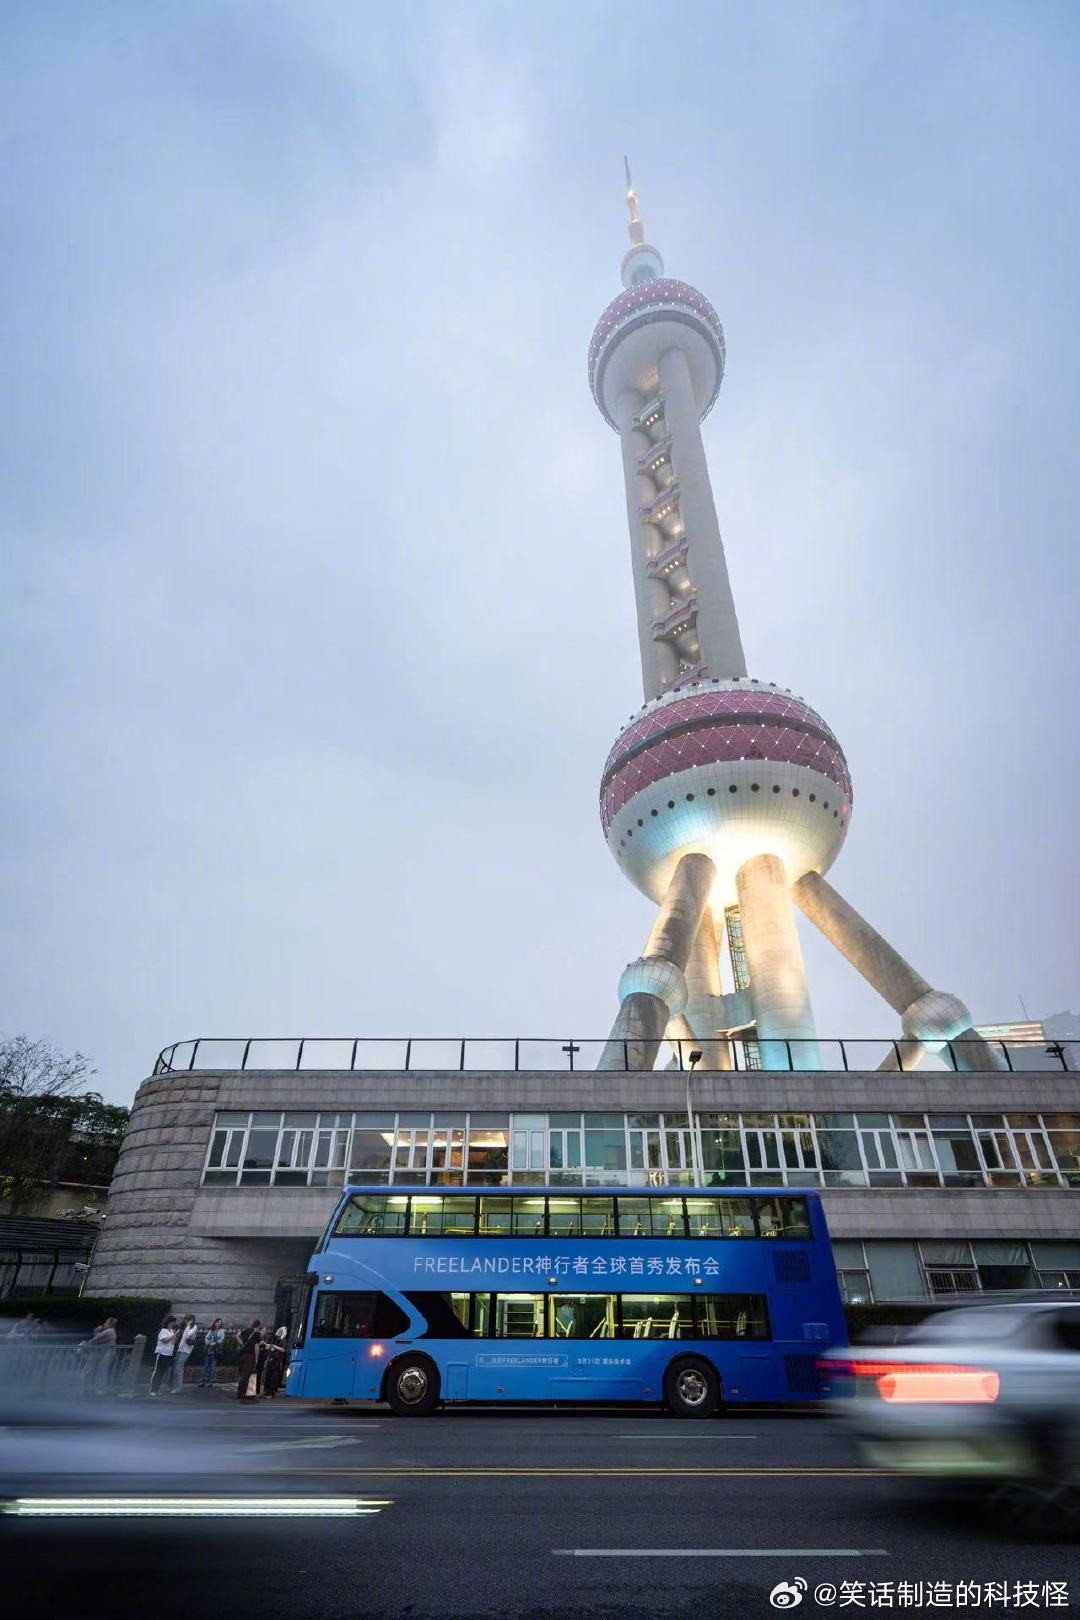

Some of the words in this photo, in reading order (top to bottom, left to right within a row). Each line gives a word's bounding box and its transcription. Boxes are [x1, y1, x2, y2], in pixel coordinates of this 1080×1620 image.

[413, 1256, 720, 1276] FREELANDER神行者全球首秀发布会
